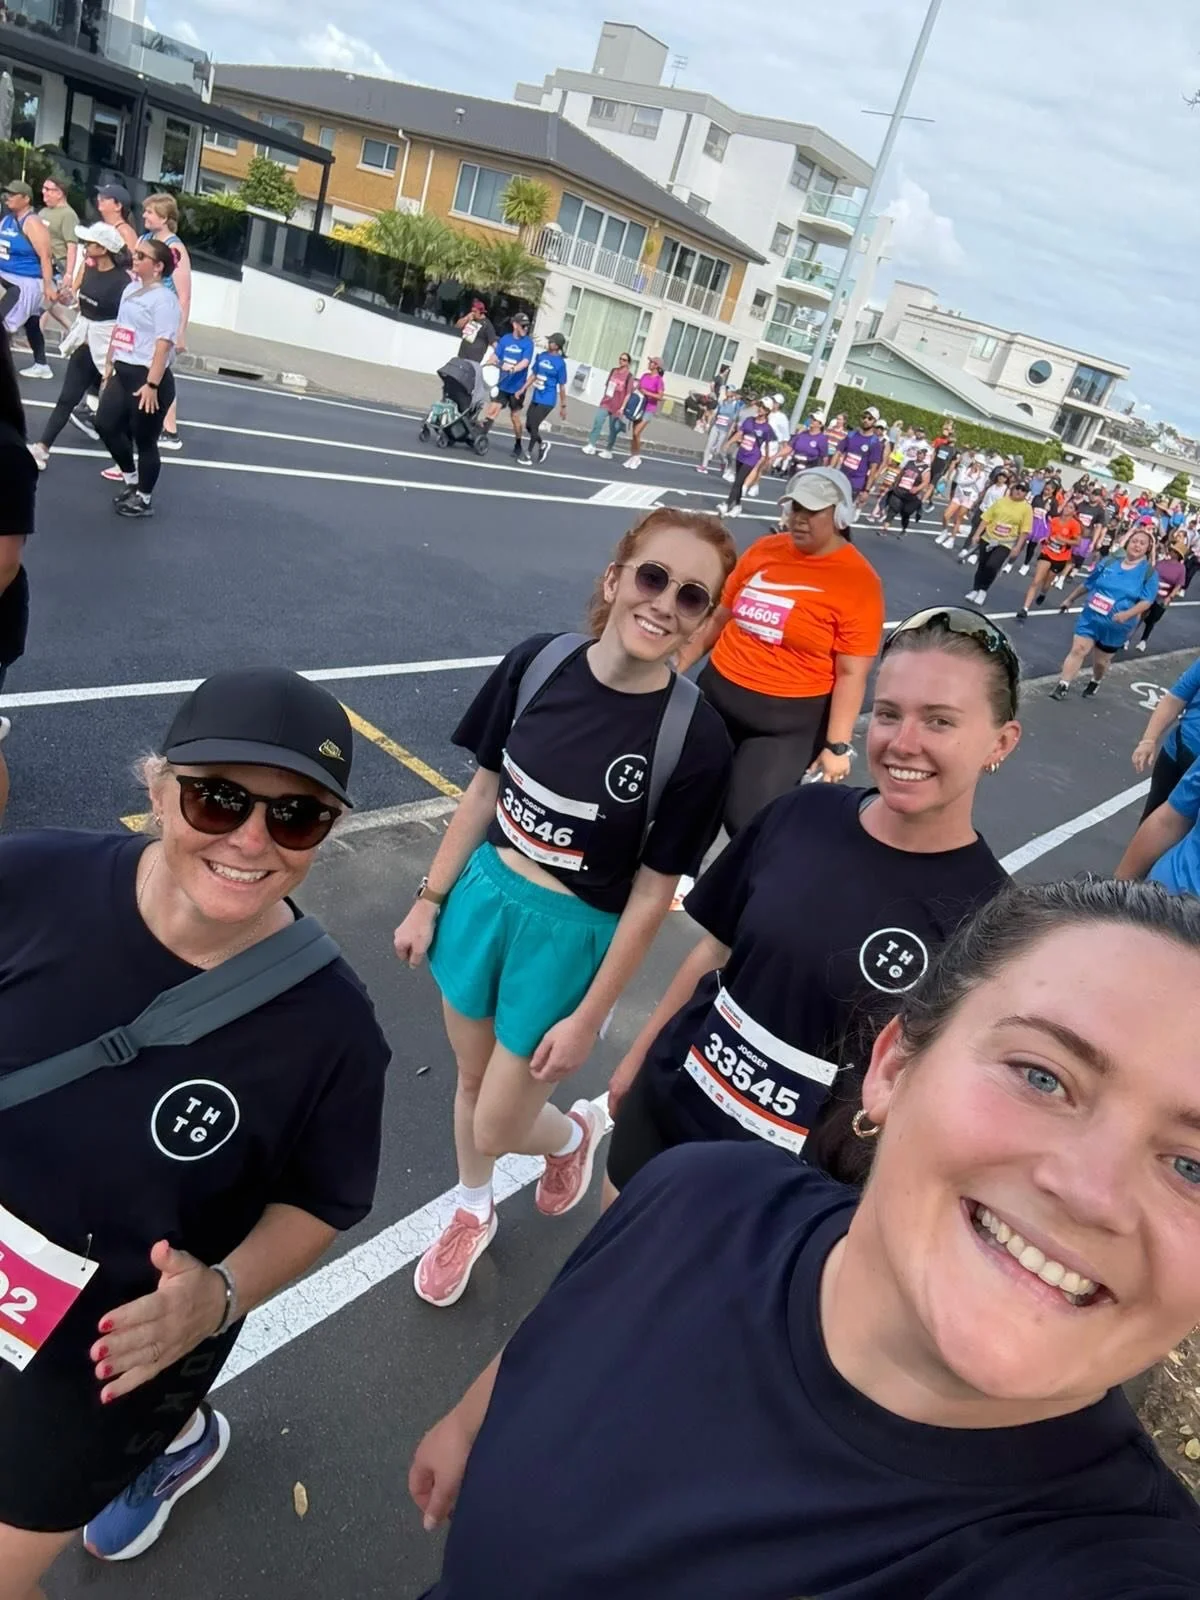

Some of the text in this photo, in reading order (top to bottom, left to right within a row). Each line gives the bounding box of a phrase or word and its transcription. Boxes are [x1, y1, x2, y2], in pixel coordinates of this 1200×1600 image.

[736, 604, 781, 625] 44605
[503, 787, 574, 847] 33546
[522, 797, 546, 816] JOGGER
[737, 1044, 769, 1070] JOGGER
[704, 1032, 800, 1116] 33545
